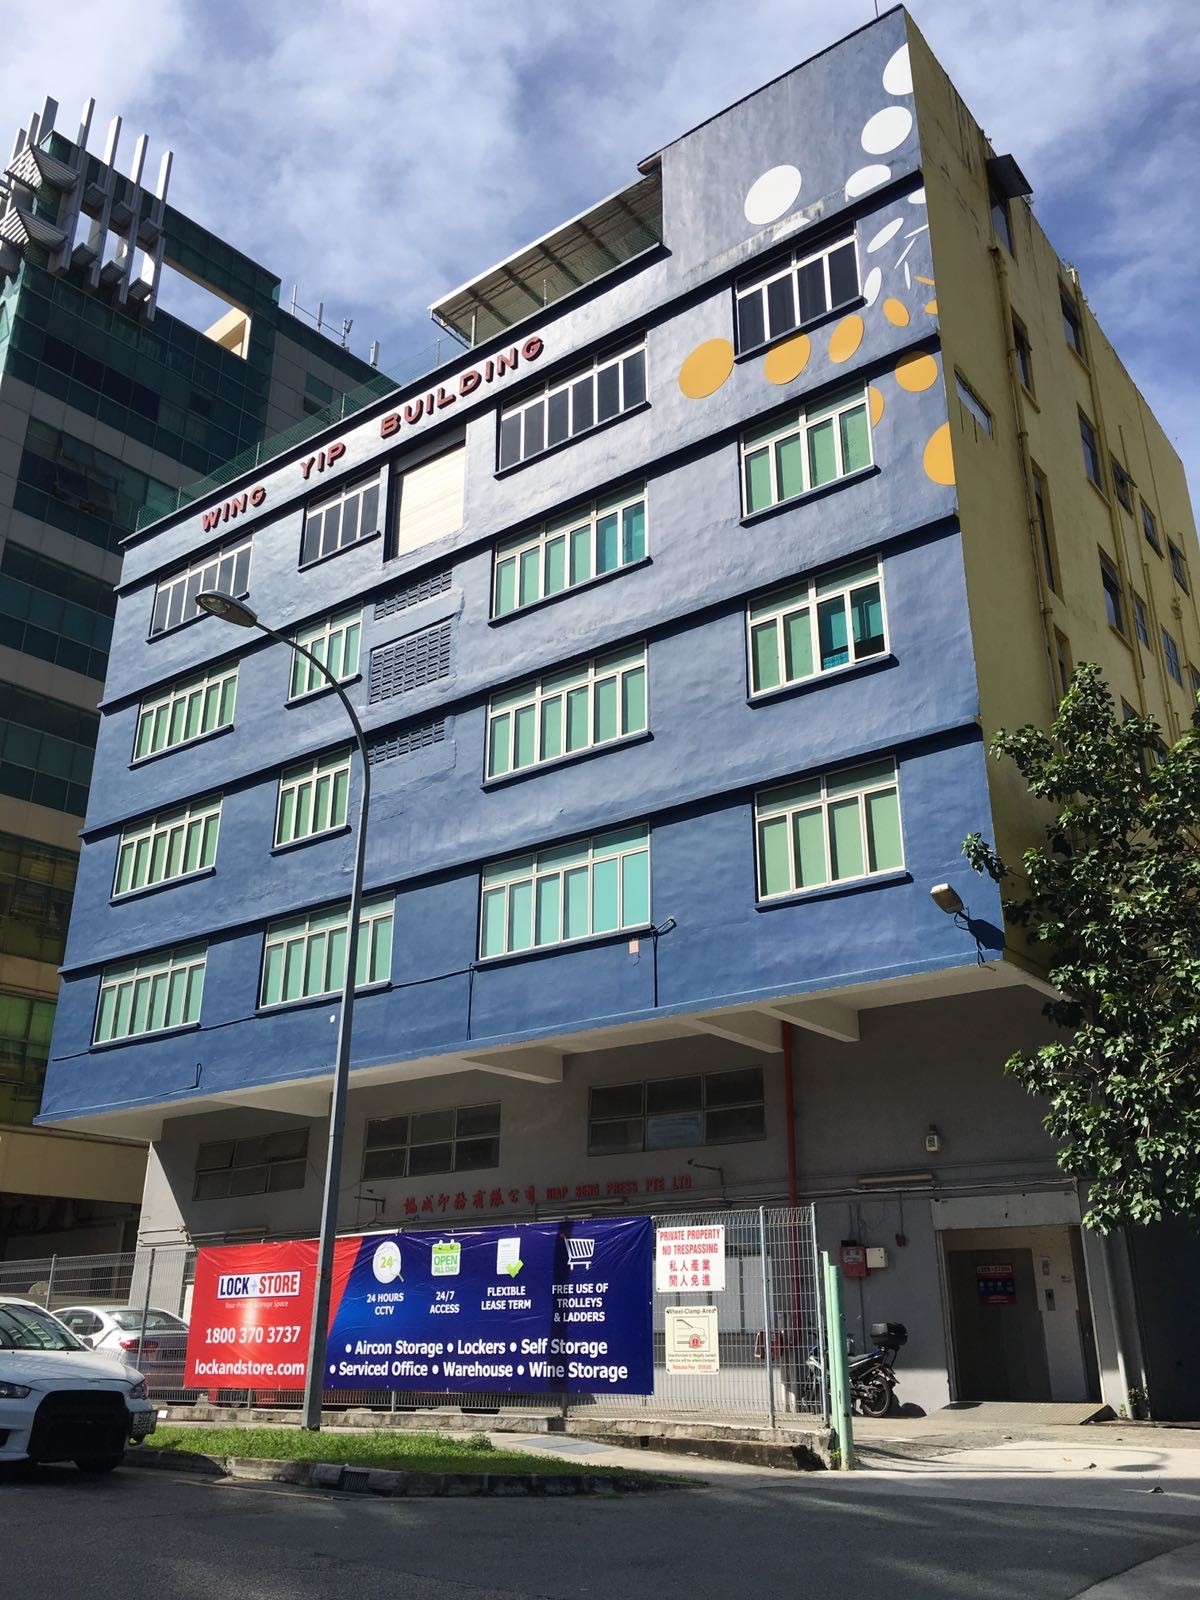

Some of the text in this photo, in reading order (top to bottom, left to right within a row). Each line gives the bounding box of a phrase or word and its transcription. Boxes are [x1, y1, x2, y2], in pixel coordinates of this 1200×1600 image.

[202, 336, 544, 533] WING YIP BUILDING
[606, 1180, 639, 1194] PRESS
[645, 1176, 665, 1192] PTE
[672, 1175, 693, 1190] LTD
[660, 1228, 721, 1241] PRIVATE PROPERTY
[662, 1243, 718, 1255] NO TRESPASSING
[380, 1256, 394, 1269] 24
[434, 1255, 458, 1266] OPEN
[487, 1286, 526, 1296] FLEXIBLE
[552, 1282, 609, 1295] FREE USE OF
[366, 1292, 404, 1303] 24 HOURS
[435, 1290, 455, 1302] 24/7
[481, 1299, 532, 1311] LEASE TERM
[557, 1297, 602, 1308] TROLLEYS
[375, 1305, 395, 1315] CCTV
[430, 1304, 460, 1314] ACCESS
[554, 1311, 605, 1322] & LADDERS
[205, 1326, 301, 1344] 1800 370 3737
[355, 1338, 608, 1358] Aircon Storage Lockers Self Storage
[195, 1359, 305, 1376] lockandstore.com
[339, 1361, 628, 1383] Serviced Office Warehouse Wine Storage
